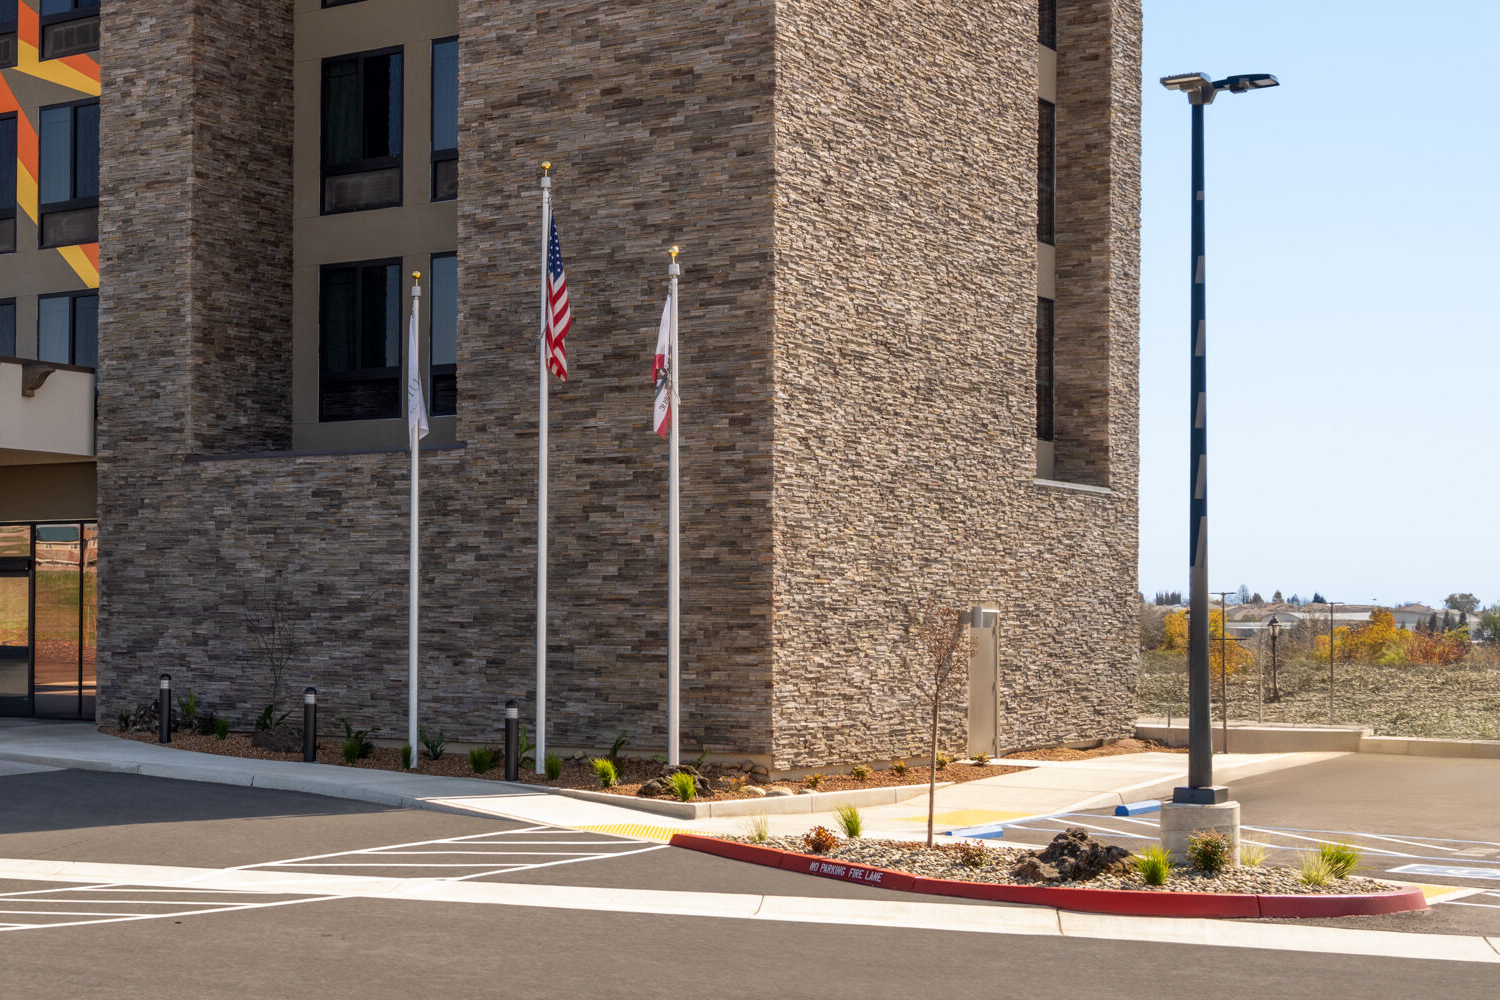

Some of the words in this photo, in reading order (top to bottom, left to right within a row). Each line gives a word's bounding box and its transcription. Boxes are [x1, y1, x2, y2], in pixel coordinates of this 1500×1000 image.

[809, 862, 820, 872] NO
[820, 863, 846, 877] PARKING
[848, 868, 864, 879] FIRE
[864, 871, 883, 882] LANE
